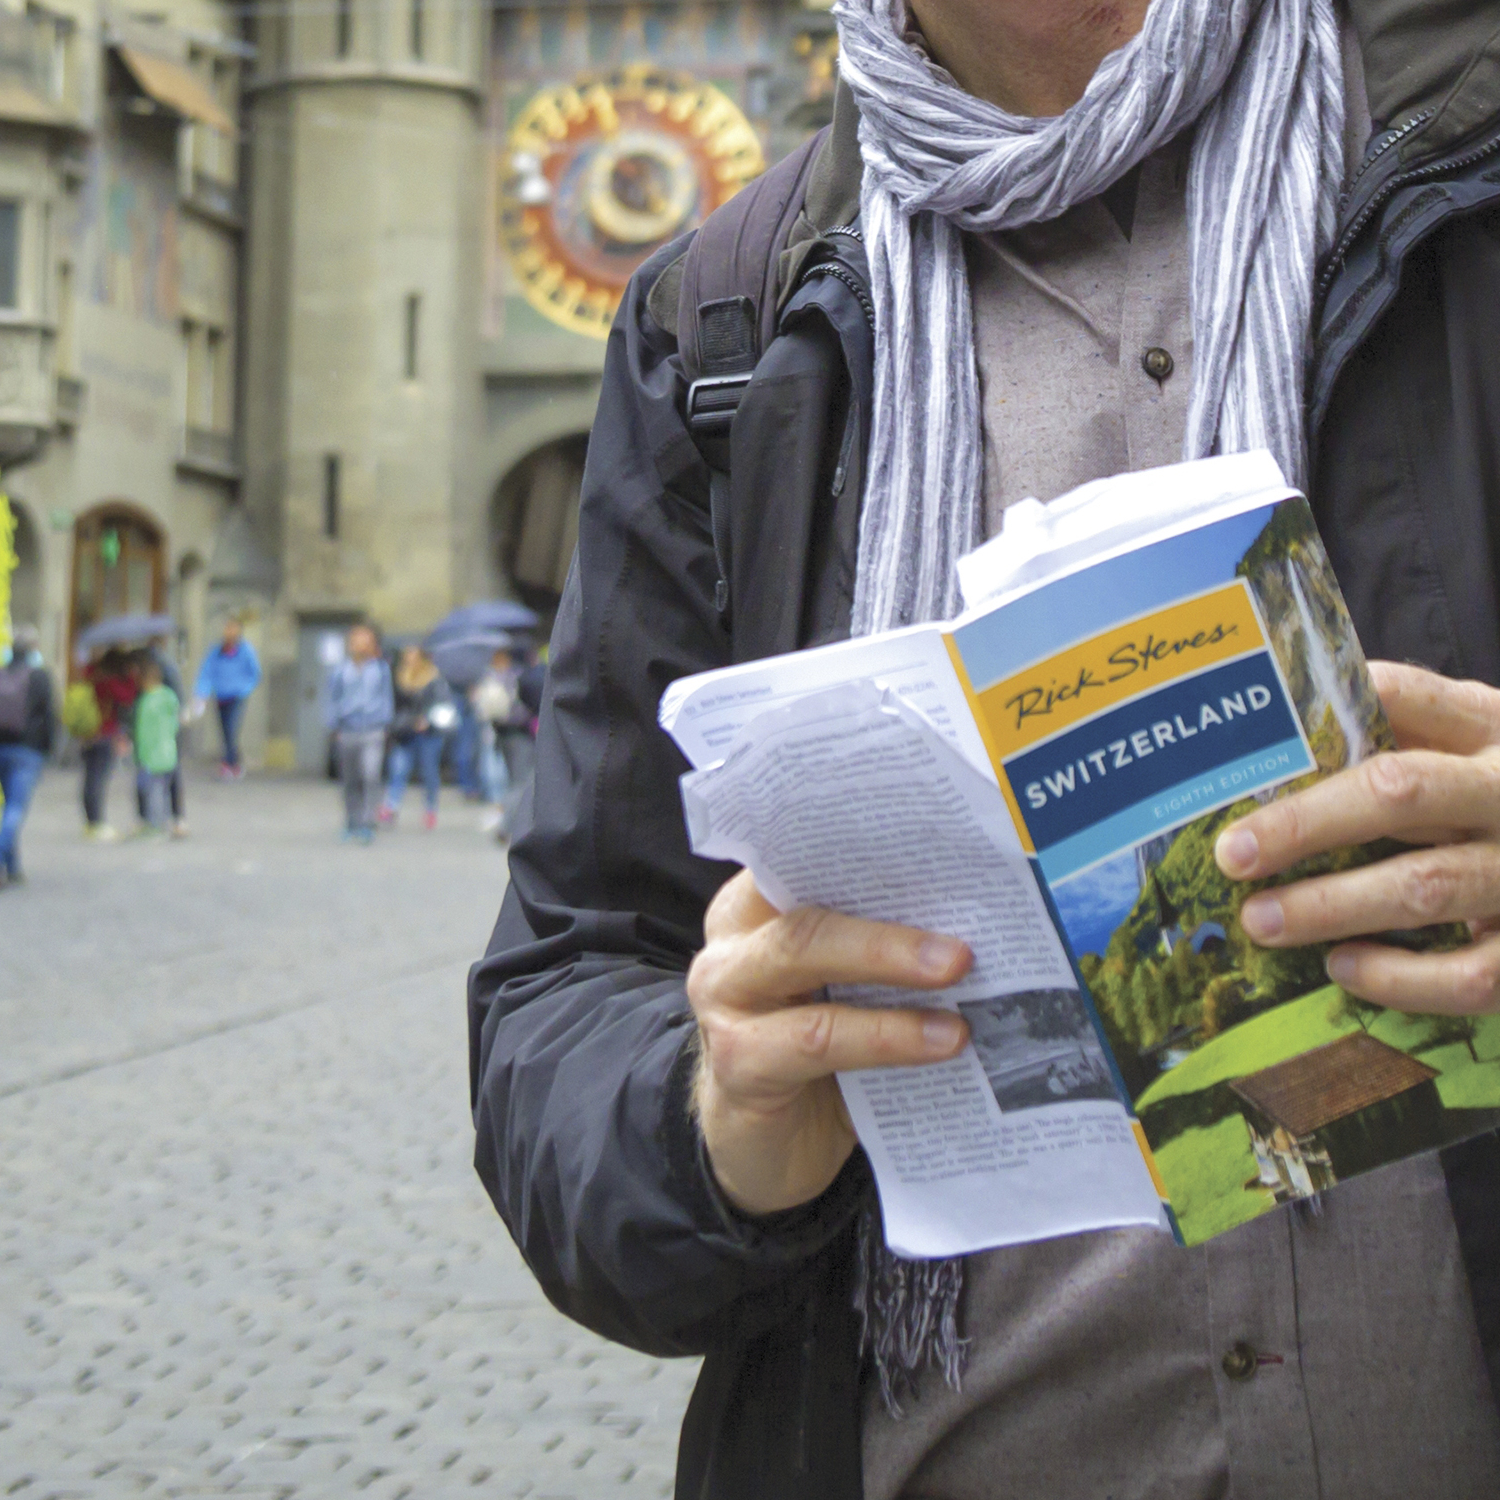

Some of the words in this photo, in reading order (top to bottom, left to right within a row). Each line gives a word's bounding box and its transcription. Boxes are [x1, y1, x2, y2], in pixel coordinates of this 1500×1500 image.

[1005, 668, 1105, 731] Rick
[1107, 623, 1238, 683] Steves
[1025, 684, 1272, 809] SWITZERLAND
[1153, 782, 1215, 818] EIGHTH
[1220, 753, 1291, 789] EDITION
